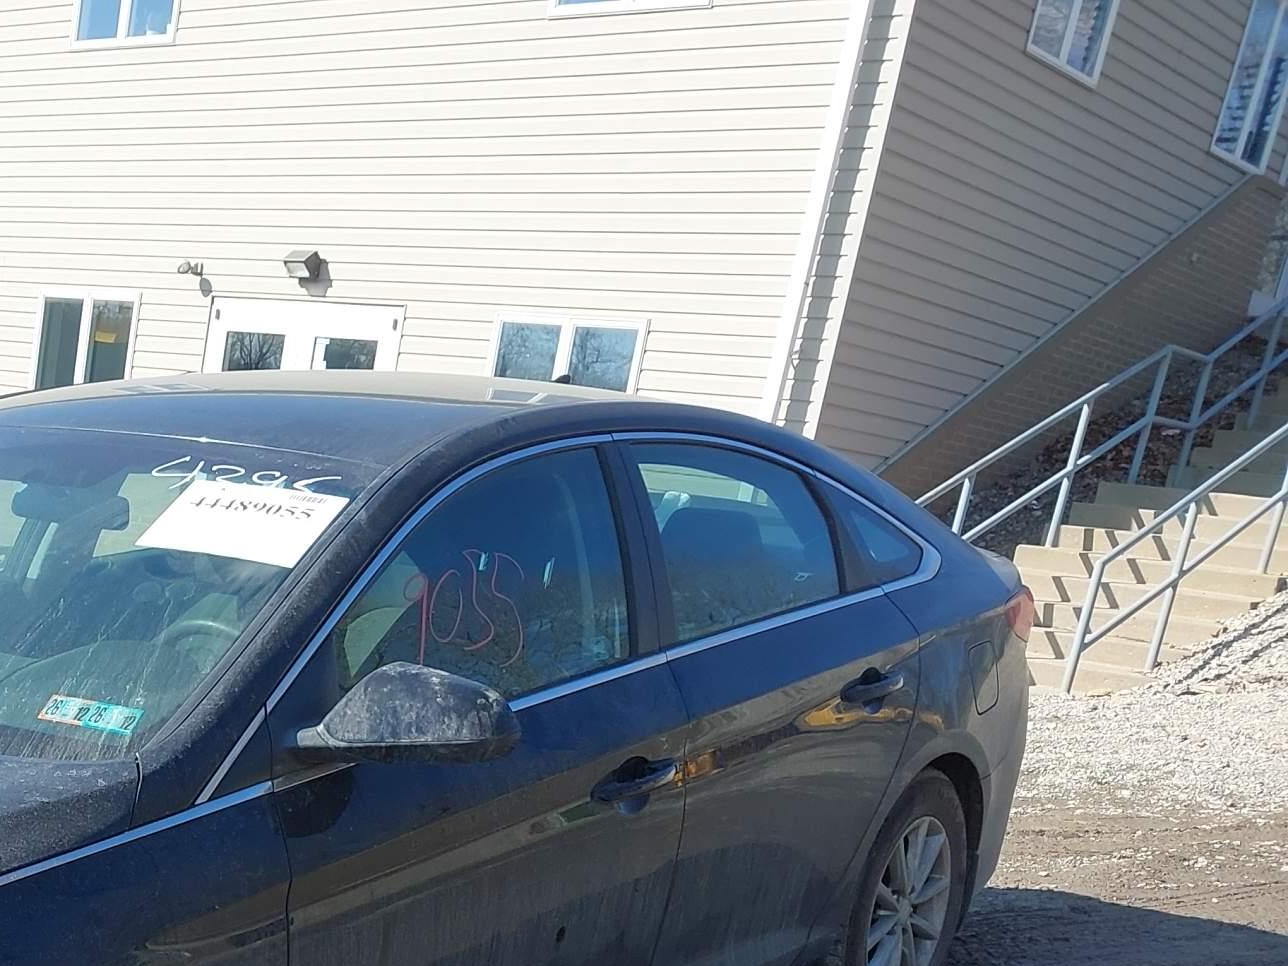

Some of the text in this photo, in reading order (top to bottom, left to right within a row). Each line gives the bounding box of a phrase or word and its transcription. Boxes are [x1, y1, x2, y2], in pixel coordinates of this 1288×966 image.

[190, 496, 315, 520] 44489055
[45, 699, 91, 721] 26 12
[88, 706, 108, 724] 26
